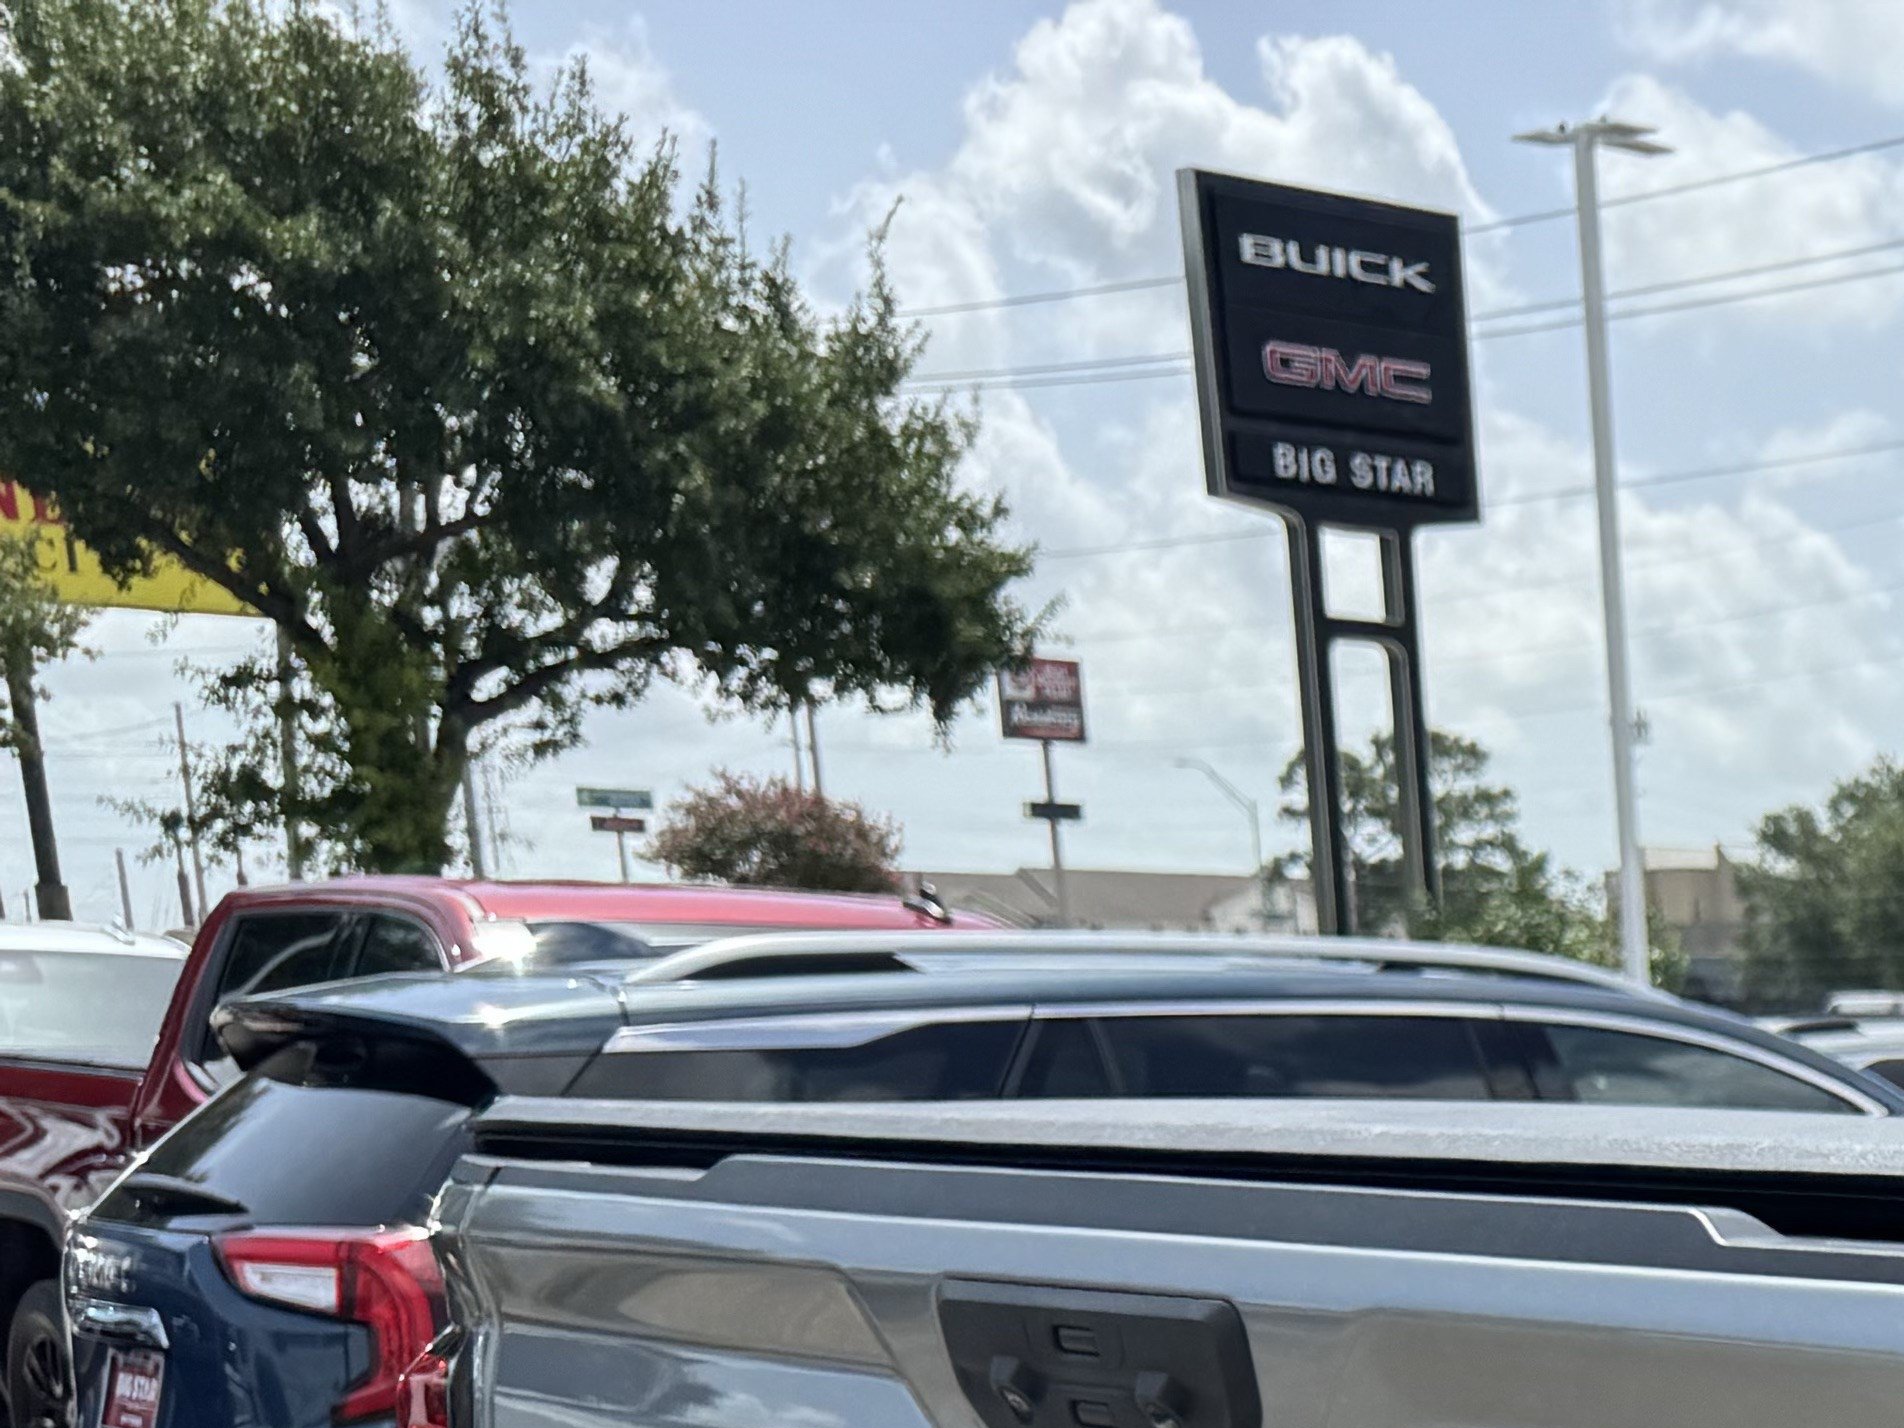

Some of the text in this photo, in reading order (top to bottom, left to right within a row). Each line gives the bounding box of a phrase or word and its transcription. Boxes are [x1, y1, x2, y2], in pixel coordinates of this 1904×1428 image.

[1238, 232, 1436, 293] BUICK
[1262, 340, 1432, 405] GMC
[1272, 441, 1435, 497] BIG STAR
